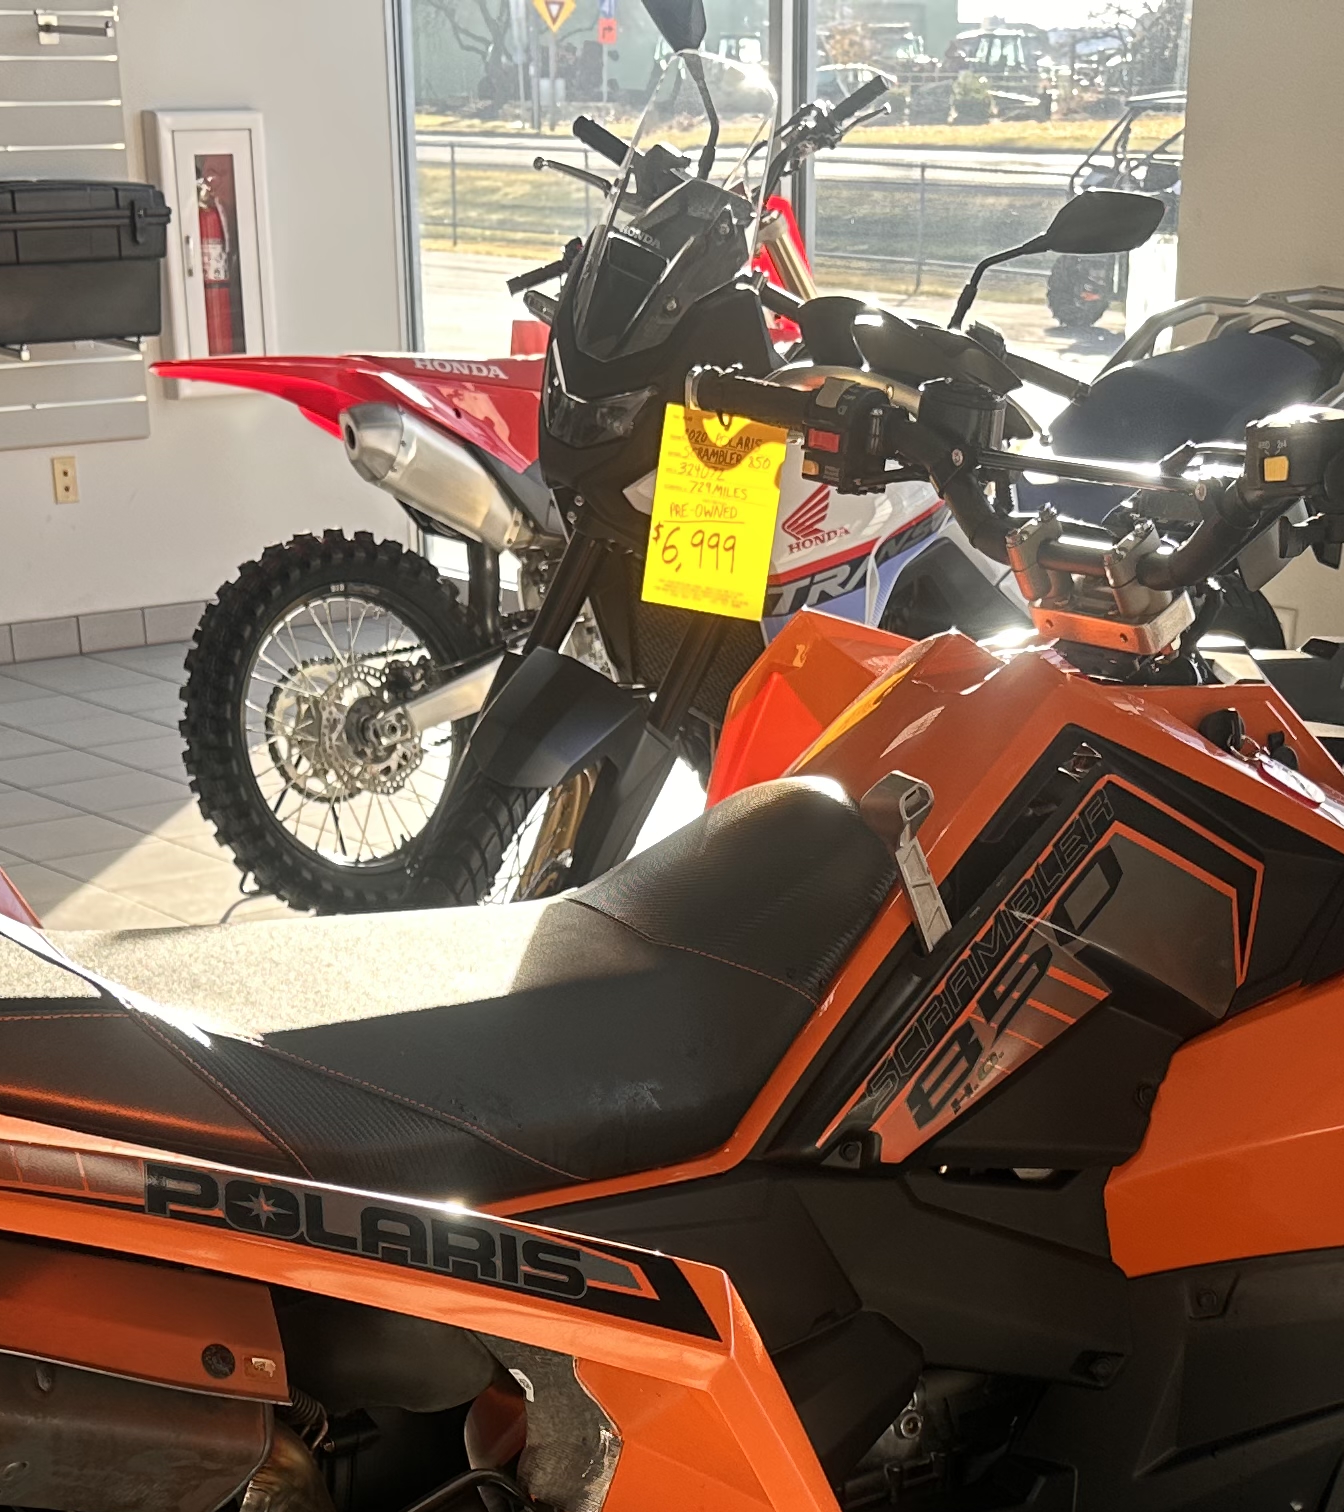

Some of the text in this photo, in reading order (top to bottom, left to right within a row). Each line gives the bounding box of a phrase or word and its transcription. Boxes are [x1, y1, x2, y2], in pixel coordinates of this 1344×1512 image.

[618, 225, 661, 250] HONDA
[413, 358, 509, 380] HONDA
[715, 432, 763, 452] POLARIS
[681, 446, 743, 466] SCRAMBLER
[712, 484, 748, 500] MILES
[669, 502, 738, 519] PRE-OWNED
[652, 521, 738, 574] $6,999
[787, 526, 851, 555] HONDA
[864, 788, 1116, 1118] SCRAMBLER
[903, 844, 1124, 1130] 850
[144, 1160, 588, 1300] POLARIS
